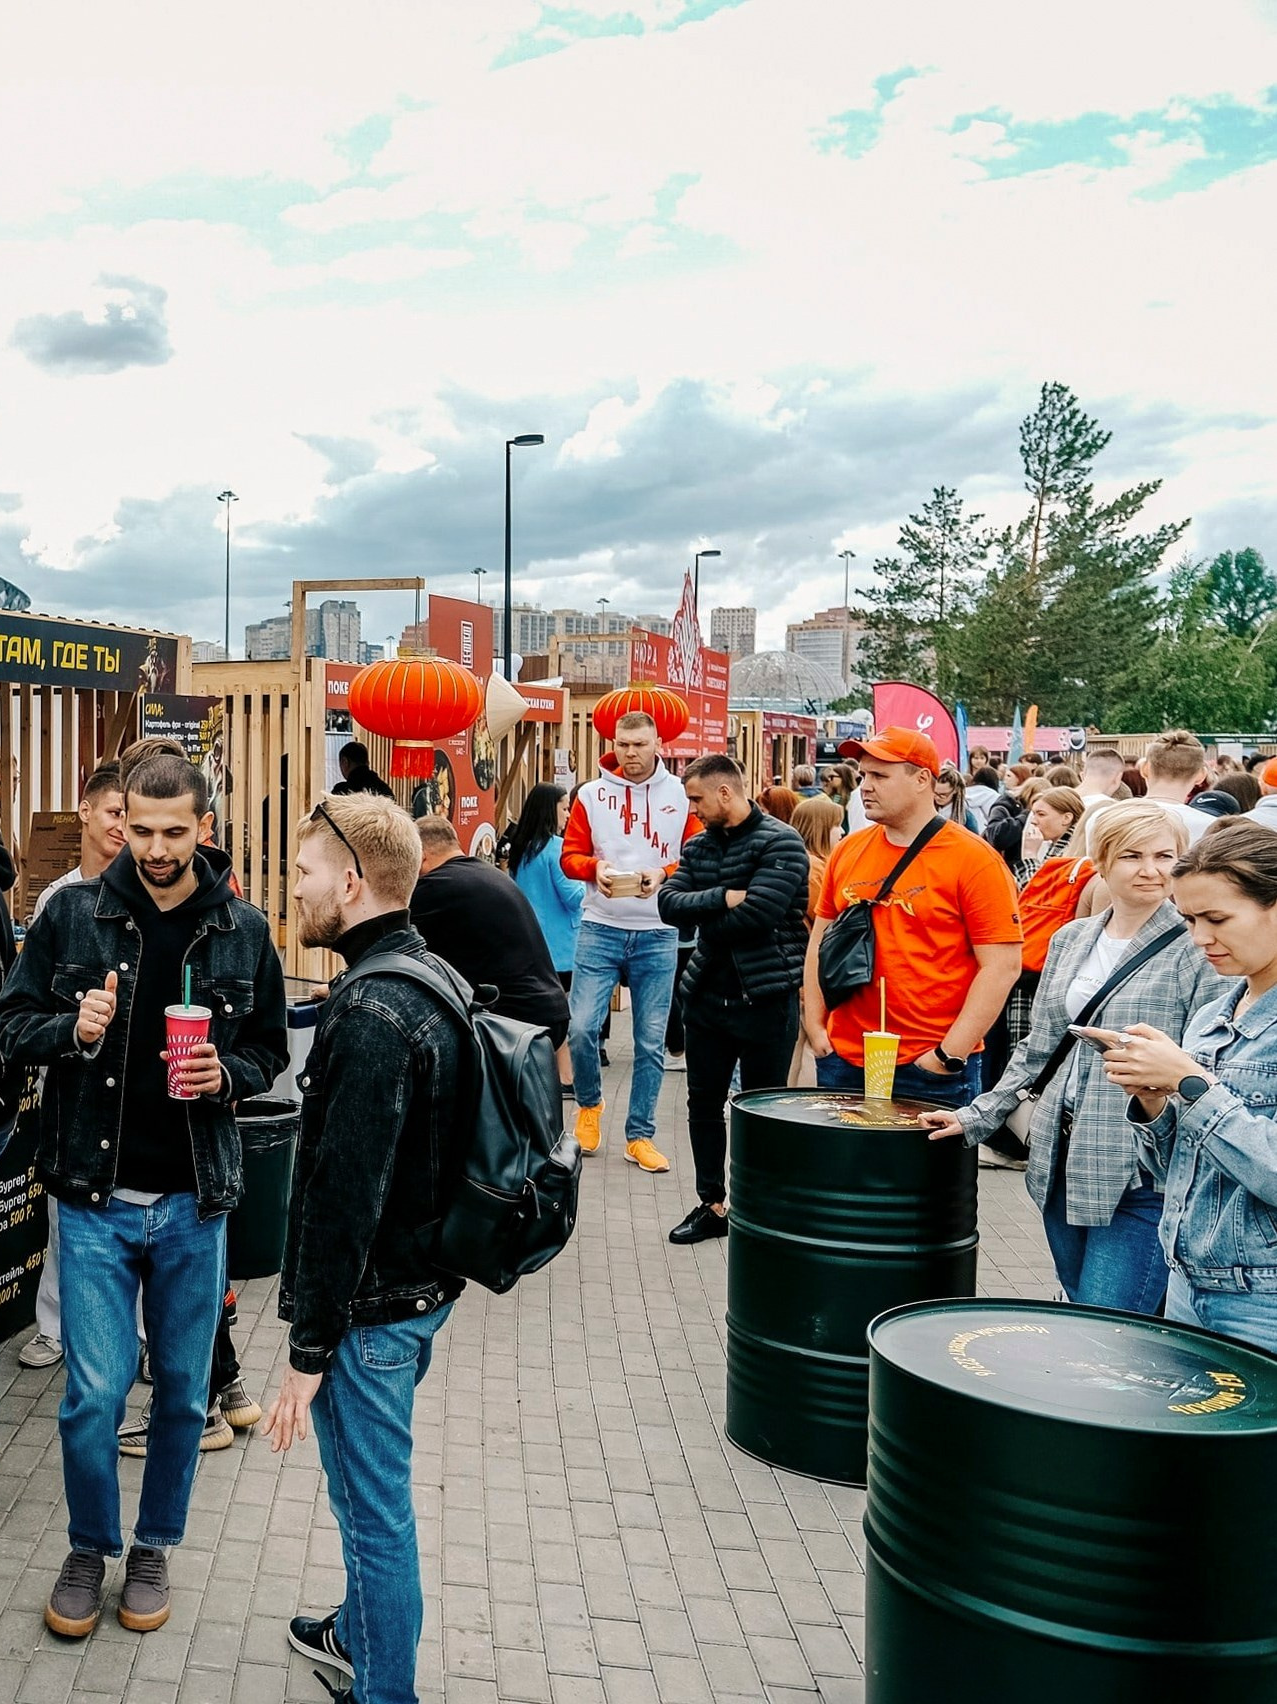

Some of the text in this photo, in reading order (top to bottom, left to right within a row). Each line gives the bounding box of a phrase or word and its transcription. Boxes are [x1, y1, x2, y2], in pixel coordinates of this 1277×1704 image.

[53, 641, 88, 670] ГДЕ
[93, 645, 120, 673] ТЫ
[53, 815, 76, 824] МЕНЮ
[19, 1095, 31, 1112] 00
[10, 1208, 24, 1227] 500
[27, 1204, 34, 1220] Р.
[26, 1252, 41, 1271] 450
[13, 1282, 20, 1299] Р.
